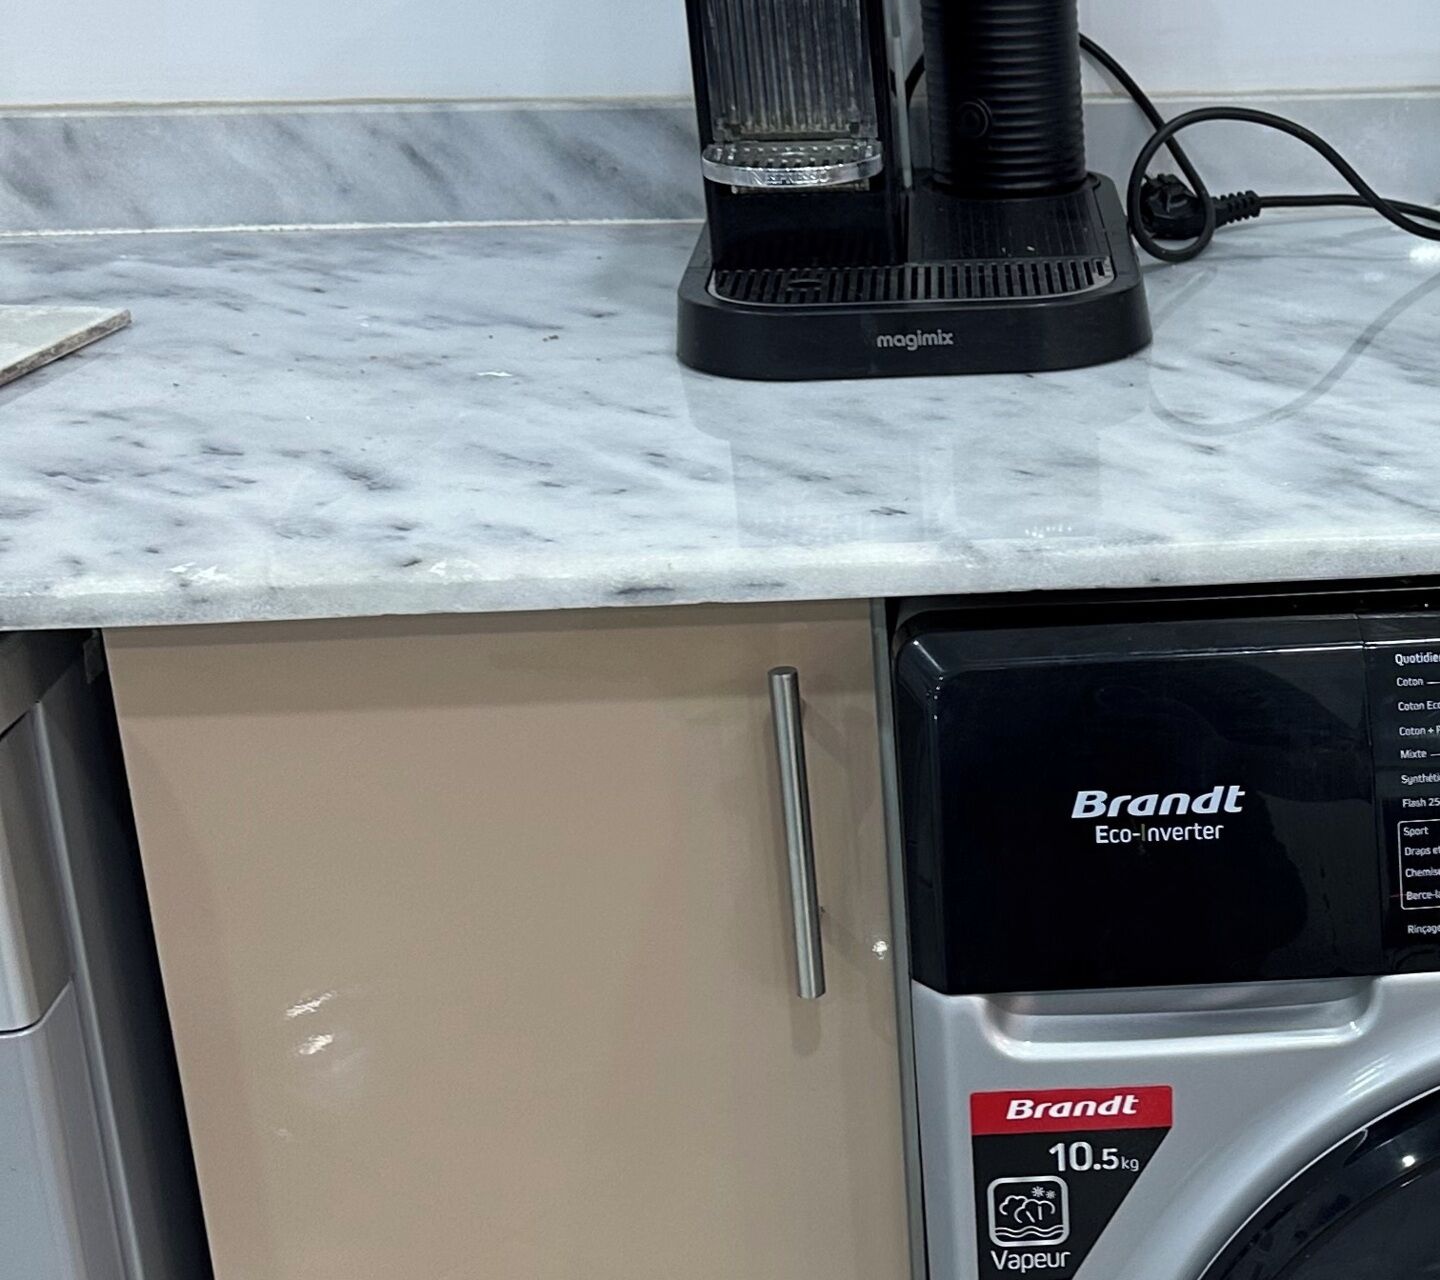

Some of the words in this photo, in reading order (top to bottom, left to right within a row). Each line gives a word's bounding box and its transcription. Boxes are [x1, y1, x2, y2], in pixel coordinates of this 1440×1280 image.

[877, 329, 953, 351] magimix
[1396, 677, 1423, 687] Coton
[1397, 702, 1425, 711] Coton
[1399, 726, 1426, 736] Coton
[1400, 749, 1427, 759] Mixte
[1071, 785, 1246, 818] Brandt
[1402, 798, 1427, 808] Flash
[1428, 797, 1440, 807] 25
[1095, 823, 1224, 843] Eco-Inverter
[1403, 826, 1429, 837] Sport
[1404, 846, 1431, 857] Draps
[1006, 1094, 1139, 1120] Brandt
[990, 1249, 1071, 1274] Vapeur
